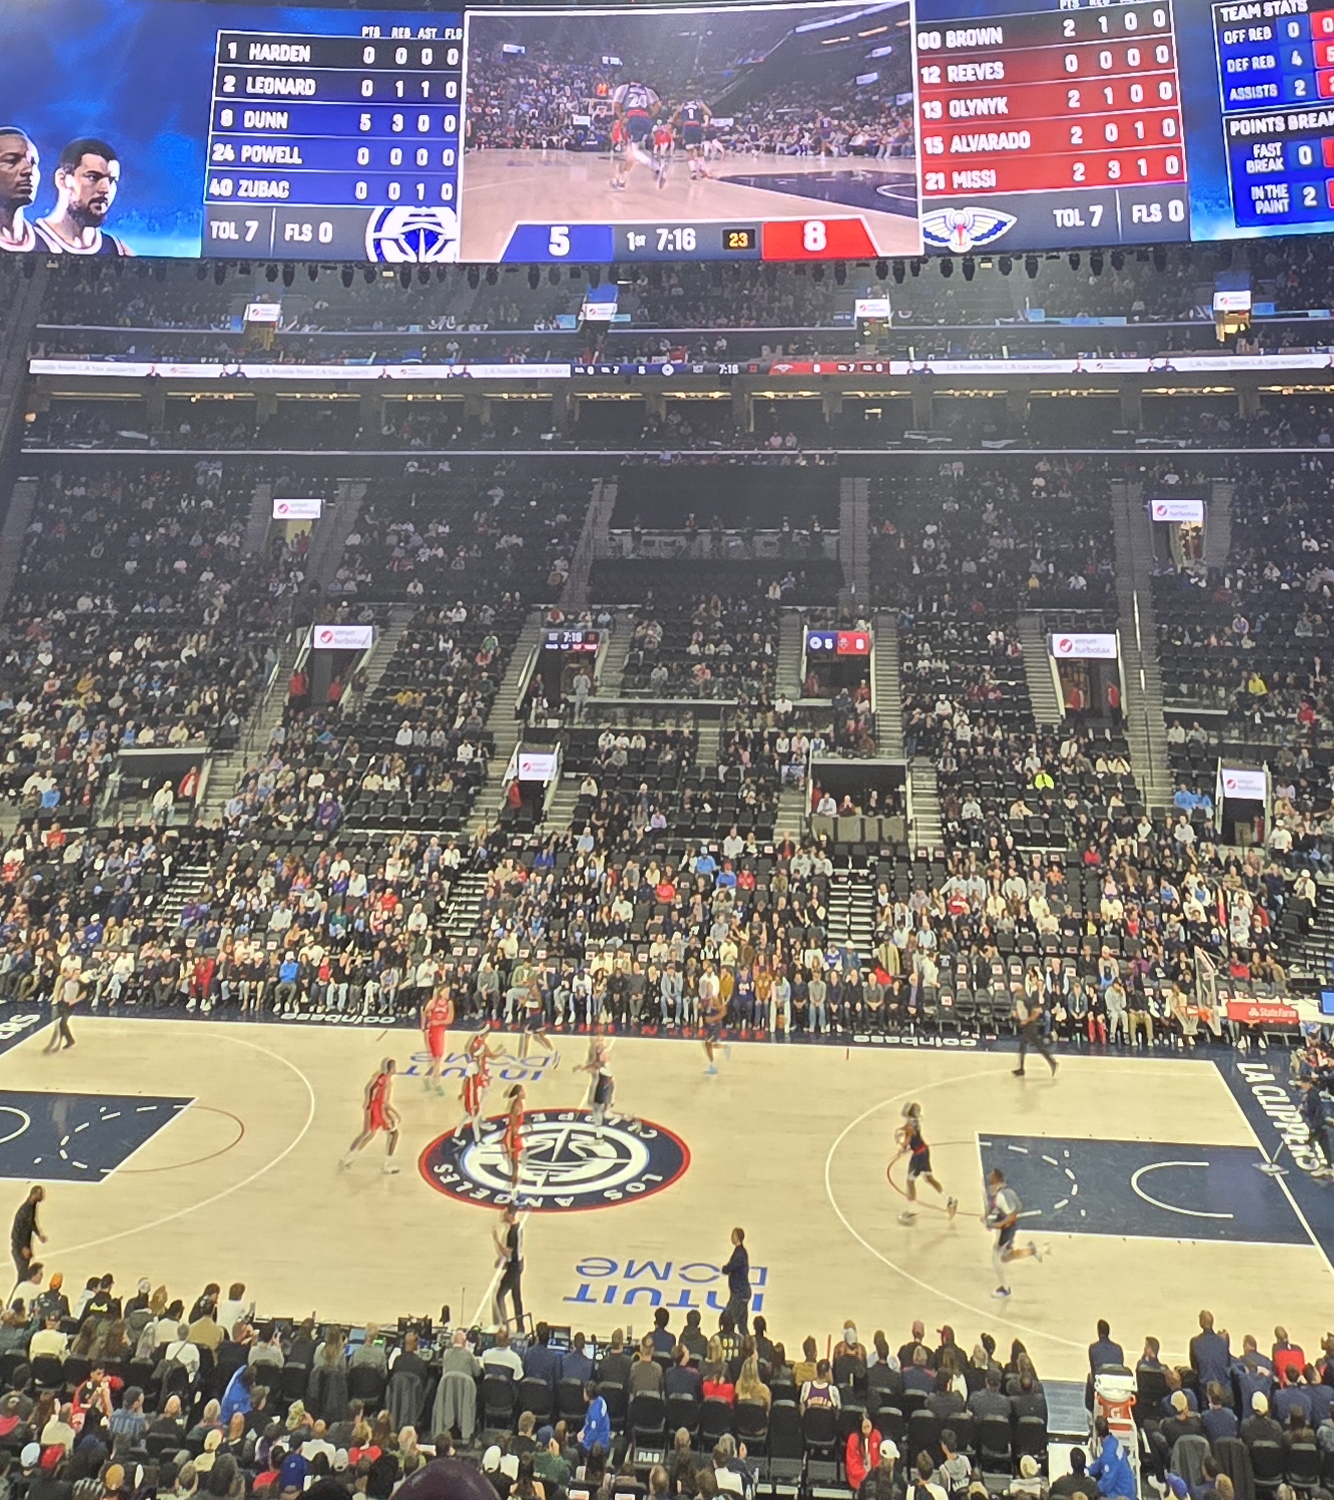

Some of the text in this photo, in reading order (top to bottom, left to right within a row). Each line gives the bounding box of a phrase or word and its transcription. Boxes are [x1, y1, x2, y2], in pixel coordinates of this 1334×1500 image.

[1220, 2, 1261, 22] TEAM
[946, 27, 1003, 48] BROWN
[249, 43, 311, 62] HARDEN
[948, 62, 1004, 81] REEVES
[246, 76, 316, 95] LEONARD
[949, 97, 1008, 117] OLYNYK
[244, 111, 288, 129] DUNN
[1230, 114, 1285, 136] POINTS
[950, 131, 1031, 153] ALVARADO
[241, 145, 302, 164] POWELL
[952, 169, 996, 188] MISSI
[238, 179, 290, 198] ZUBAC
[548, 221, 826, 257] 5 1ST 7:16 23 8
[1237, 1063, 1275, 1082] LA
[604, 1174, 663, 1200] LOS
